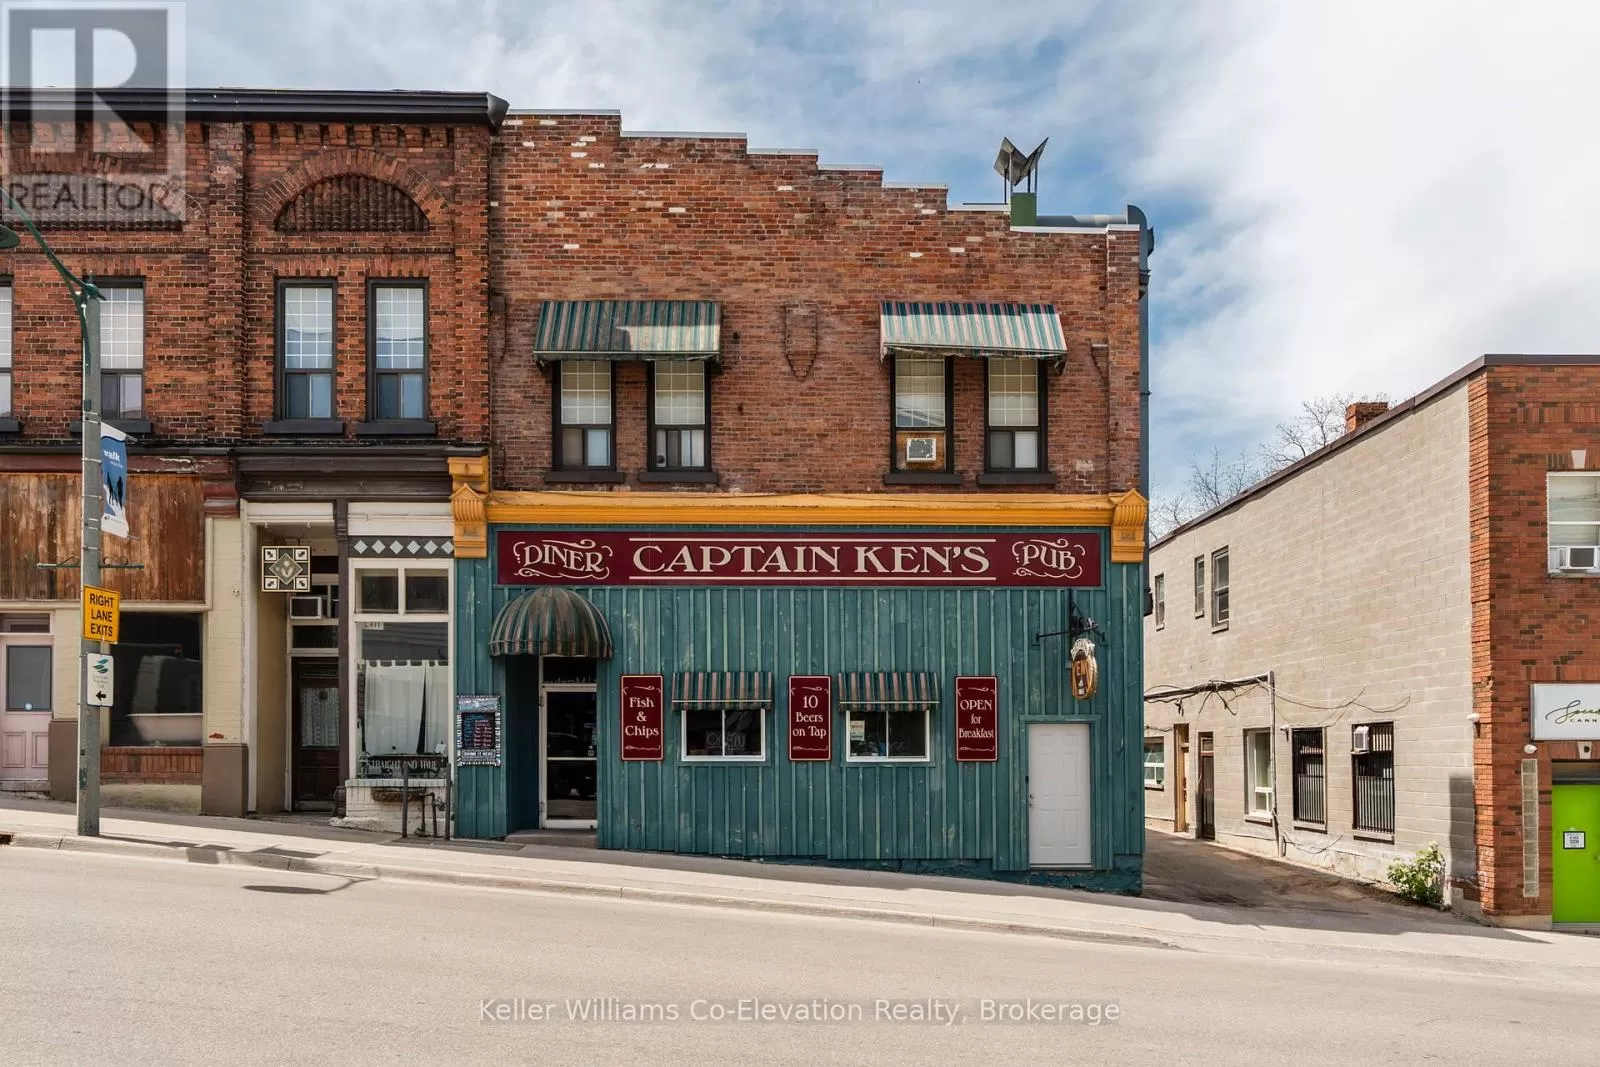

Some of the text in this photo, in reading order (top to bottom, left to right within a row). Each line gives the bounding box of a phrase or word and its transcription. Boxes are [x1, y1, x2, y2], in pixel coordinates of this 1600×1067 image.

[523, 544, 605, 572] DINER
[633, 545, 990, 573] CAPTAIN KEN'S
[1022, 544, 1076, 571] PUB
[89, 593, 114, 608] RIGHT
[91, 609, 112, 622] LANE
[90, 623, 113, 636] EXITS
[629, 697, 655, 708] Fish
[803, 694, 819, 709] 10
[960, 699, 993, 711] OPEN
[636, 711, 648, 722] &
[795, 711, 824, 723] Beers
[970, 713, 982, 725] for
[624, 725, 660, 739] Chips
[792, 725, 827, 739] on Tap
[958, 727, 995, 739] Breakfast
